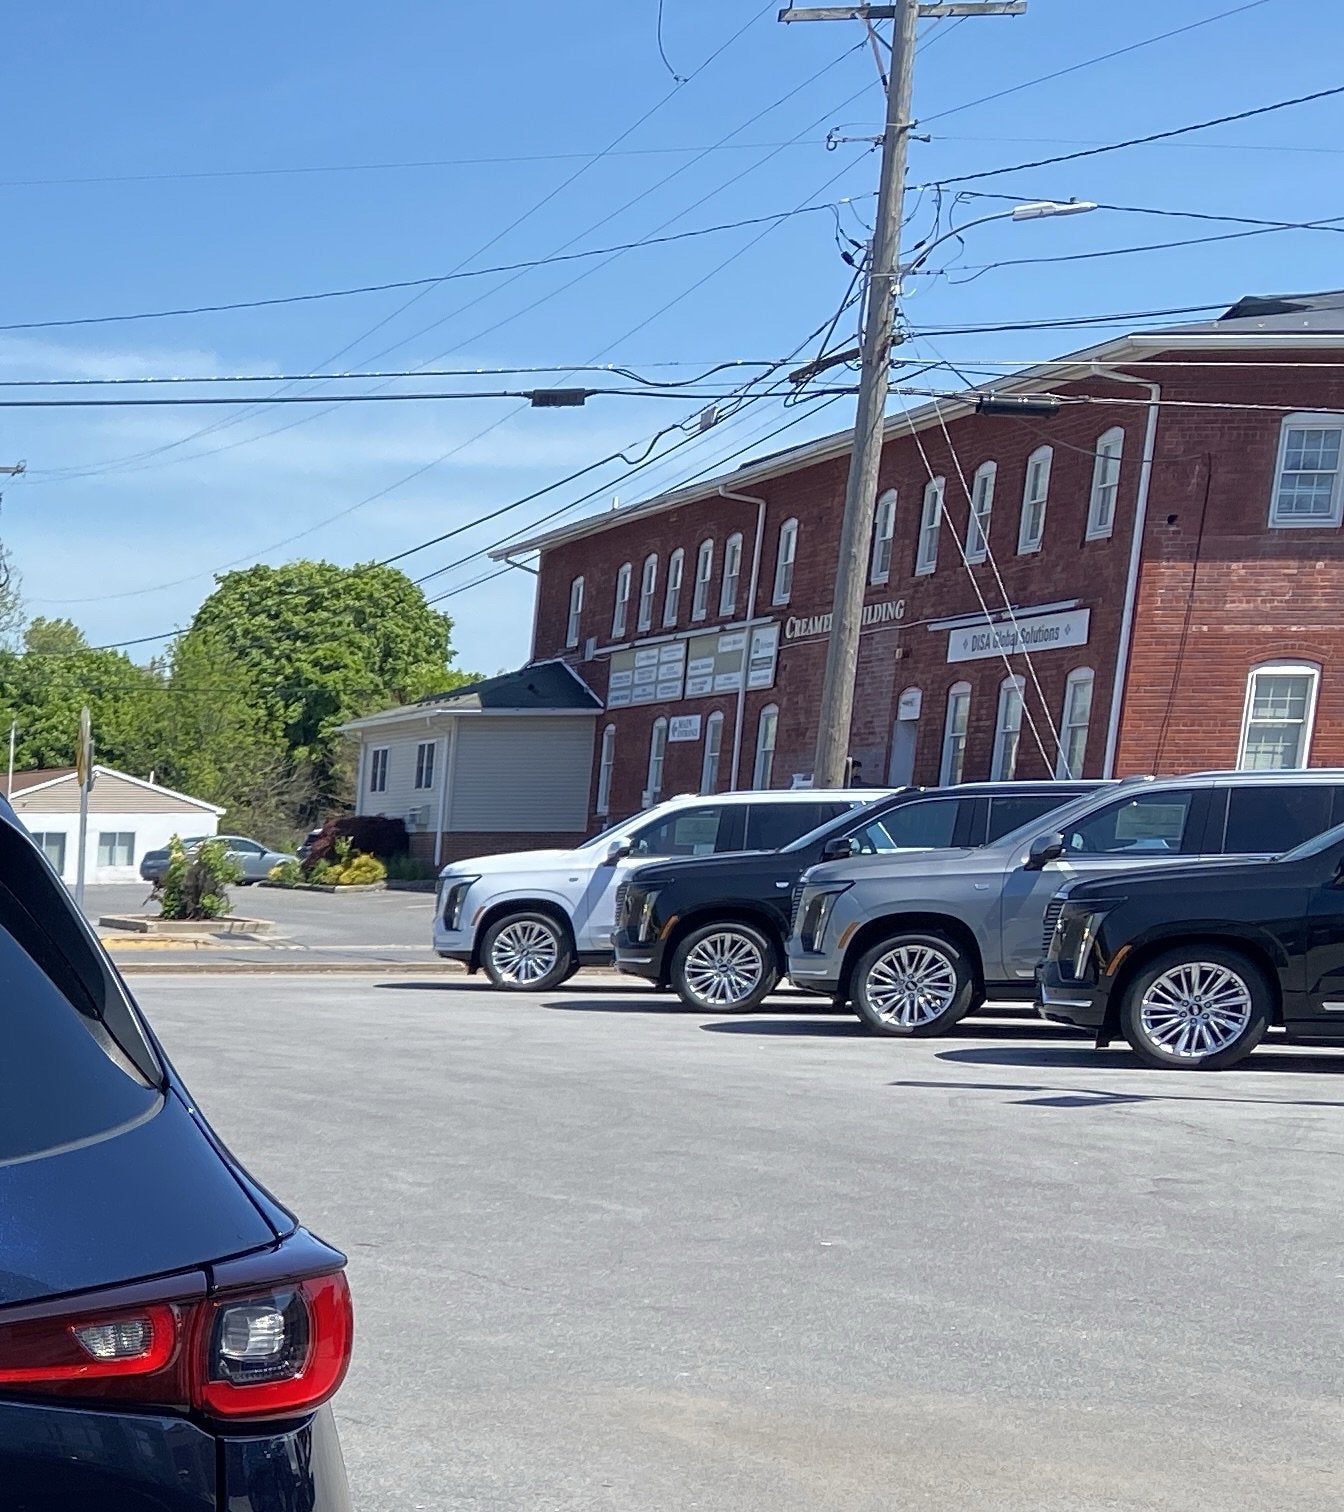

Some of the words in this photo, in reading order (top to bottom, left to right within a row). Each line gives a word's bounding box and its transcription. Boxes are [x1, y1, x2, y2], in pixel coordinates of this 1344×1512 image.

[785, 613, 833, 638] CREAME
[862, 600, 905, 625] ILDING
[972, 633, 990, 651] DISA
[1021, 624, 1060, 643] Solutions
